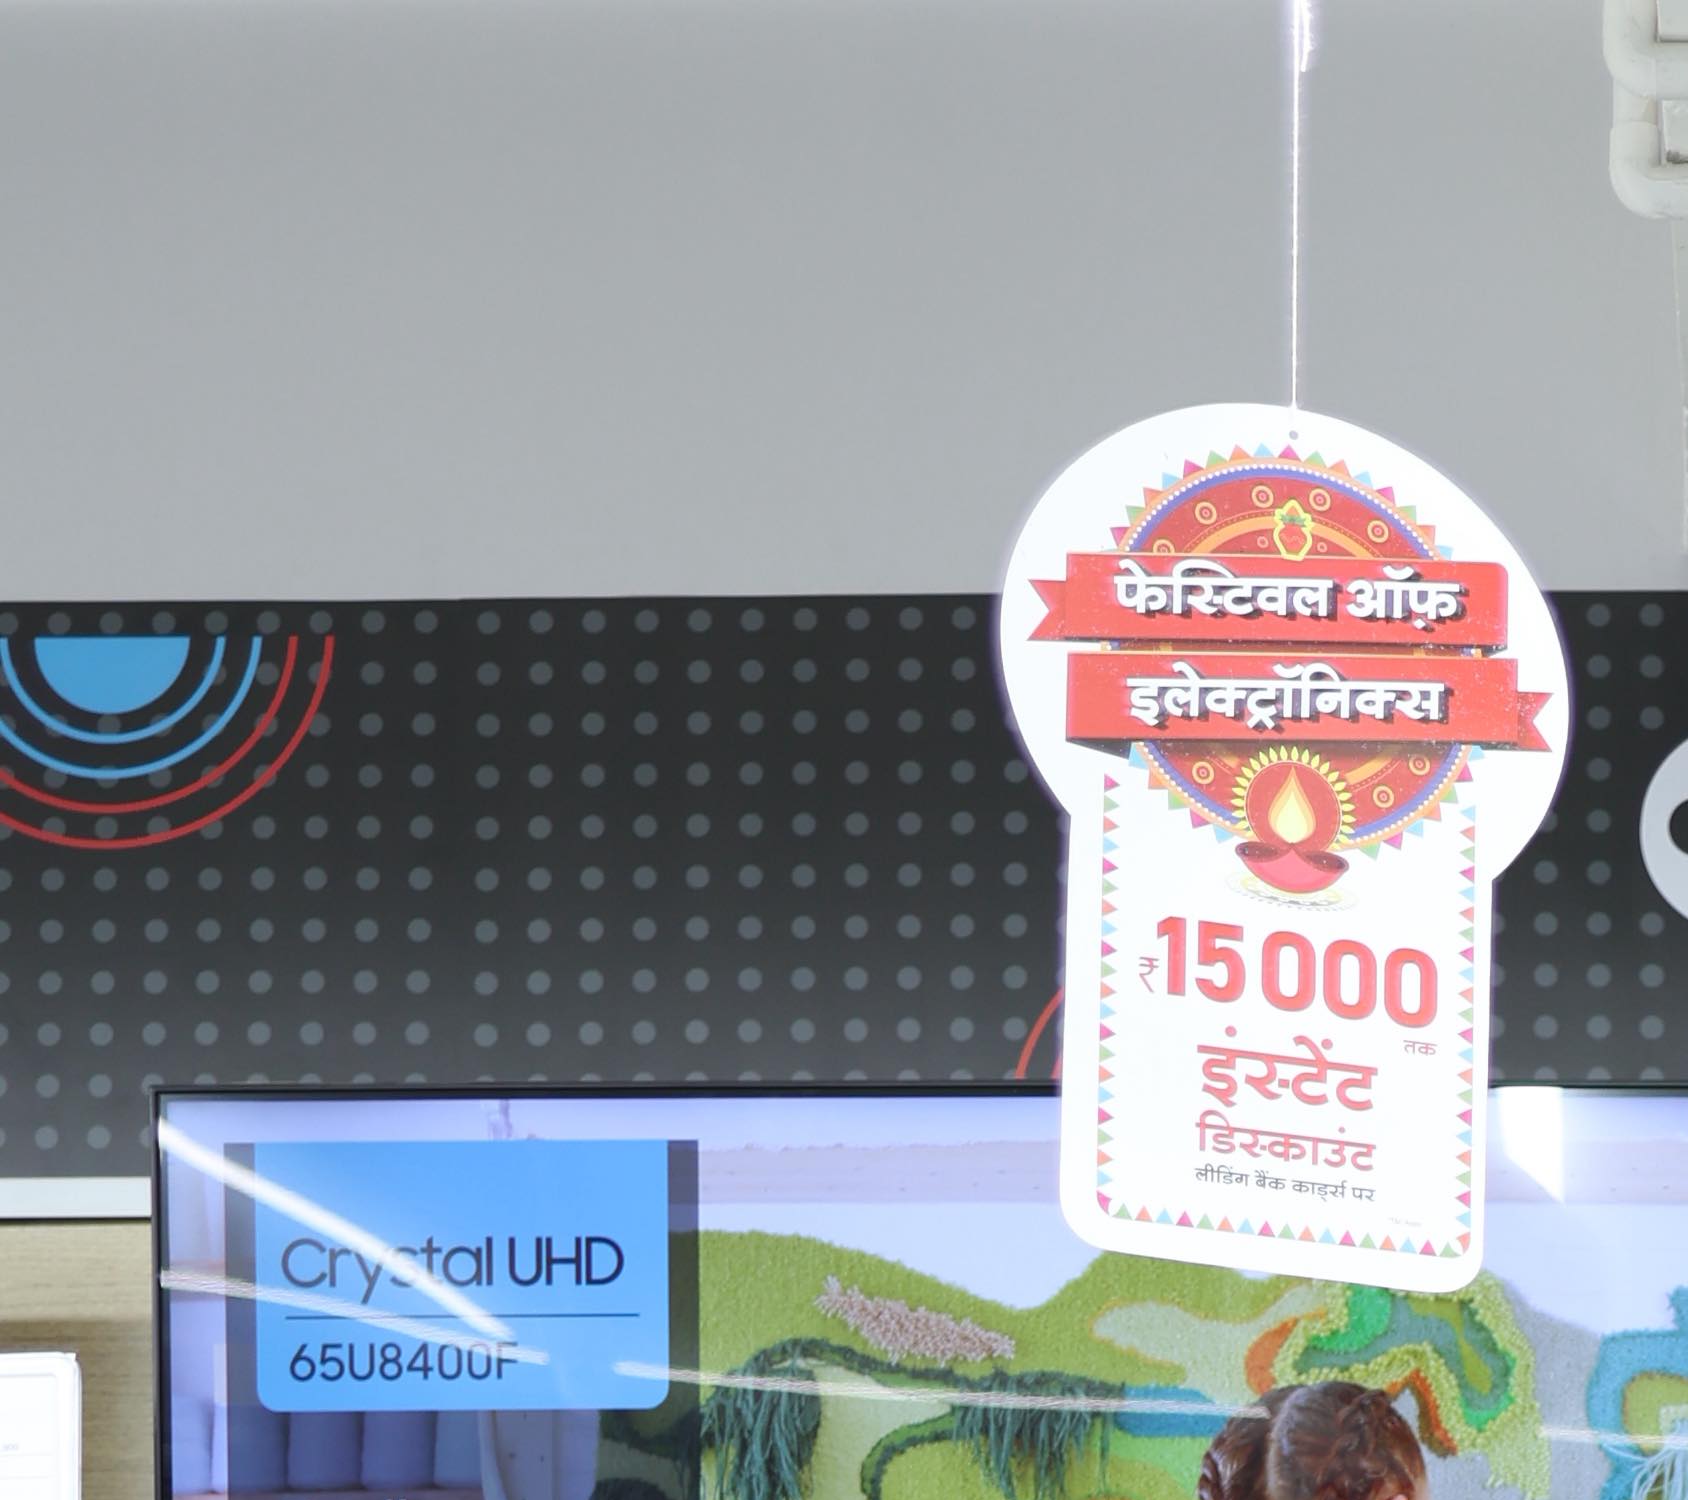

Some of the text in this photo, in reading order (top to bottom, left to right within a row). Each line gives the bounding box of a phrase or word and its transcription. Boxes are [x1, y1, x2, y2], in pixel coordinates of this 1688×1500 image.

[1113, 558, 1461, 629] फेस्टिवल ऑफ़
[1126, 661, 1445, 730] इलेक्ट्रॉनिक्स
[1197, 1025, 1378, 1112] इंस्टेंट
[1403, 1039, 1438, 1057] तक
[1195, 1110, 1376, 1171] डिस्काउंट
[1195, 1163, 1250, 1187] लीडिंग
[1255, 1170, 1286, 1191] बैंक
[1351, 1186, 1376, 1201] पर
[281, 1235, 625, 1305] Crystal UHD
[289, 1341, 519, 1382] 65U8400F
